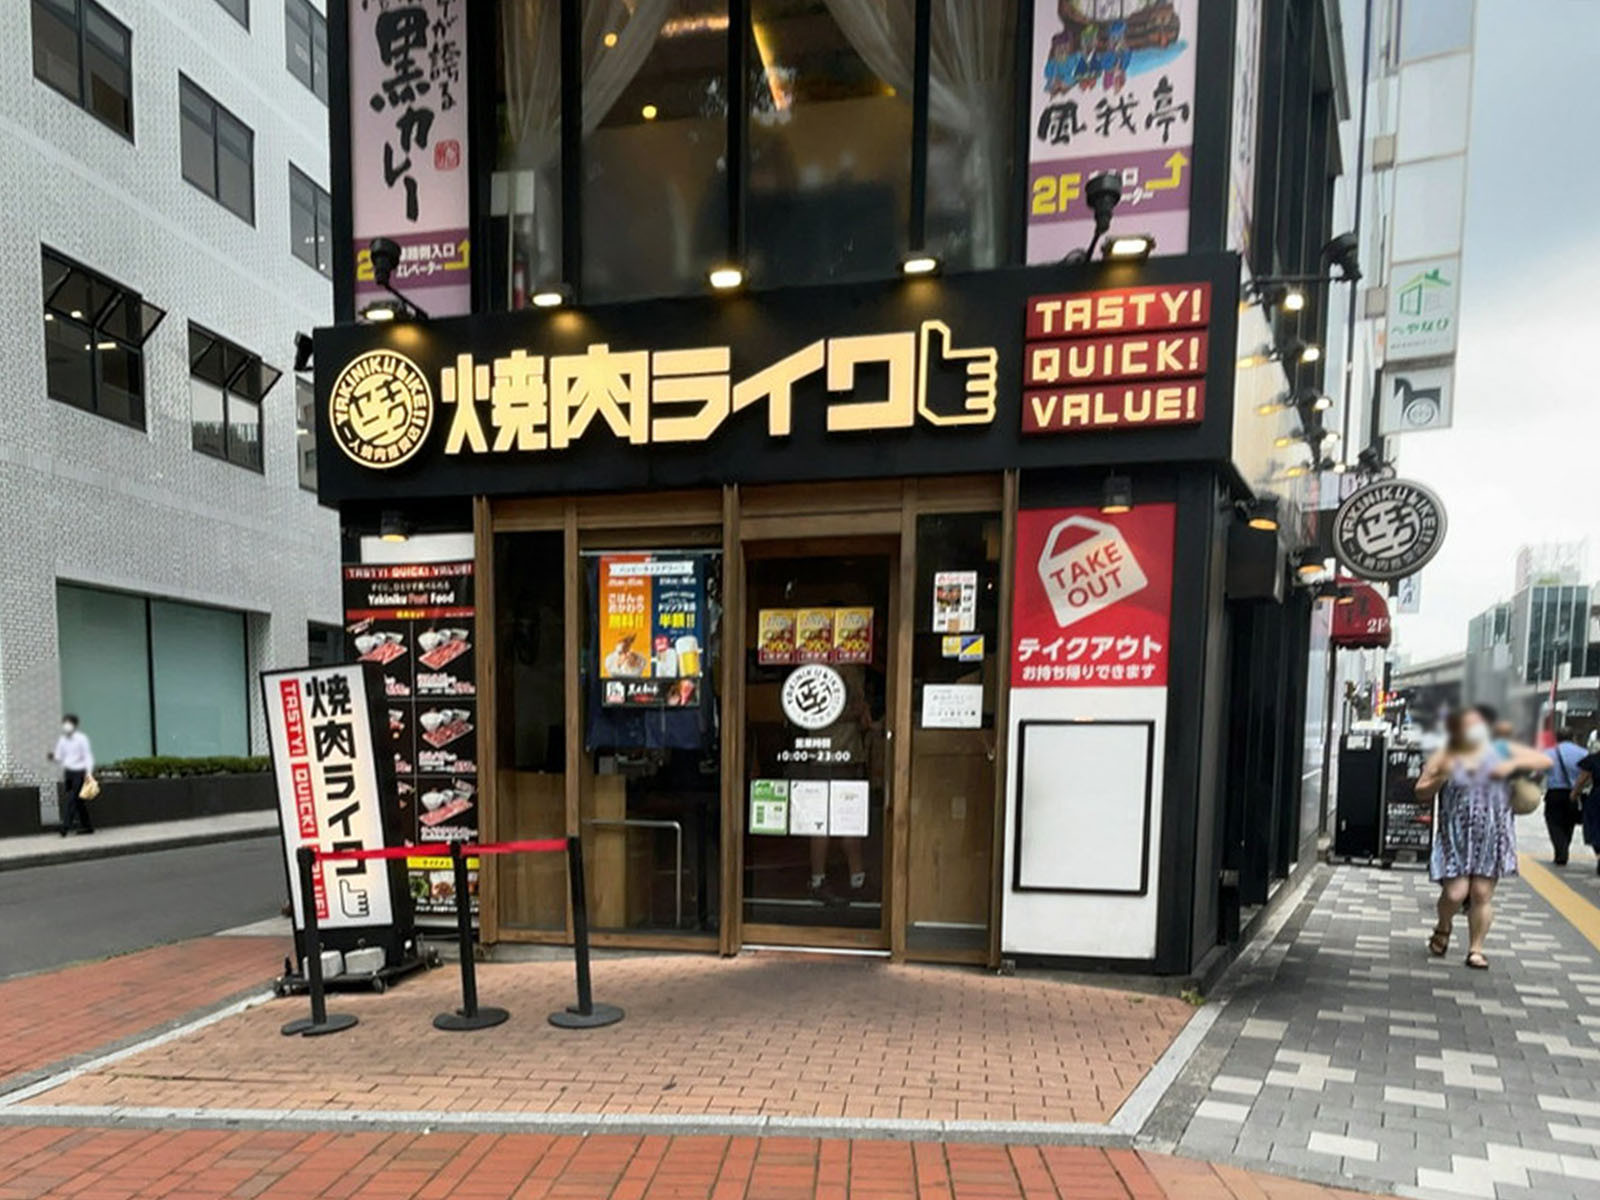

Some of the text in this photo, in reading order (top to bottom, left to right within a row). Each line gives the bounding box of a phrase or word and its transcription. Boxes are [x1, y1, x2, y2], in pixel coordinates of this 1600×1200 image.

[370, 8, 435, 222] 黒カレー
[1037, 75, 1189, 145] 風我亭
[1032, 173, 1081, 215] 2F
[1035, 289, 1201, 333] TASTY!
[1032, 338, 1200, 383] QUICK!
[441, 331, 916, 454] 焼肉ライク
[1031, 387, 1197, 428] VALUE!
[1050, 541, 1123, 590] TAKE
[1067, 566, 1122, 608] OUT
[1018, 635, 1162, 662] テイクアウト
[1022, 664, 1156, 682] お持ち帰りできます
[283, 683, 302, 755] TASTY!
[306, 673, 367, 876] 焼肉ライク
[294, 769, 316, 835] QUICK!
